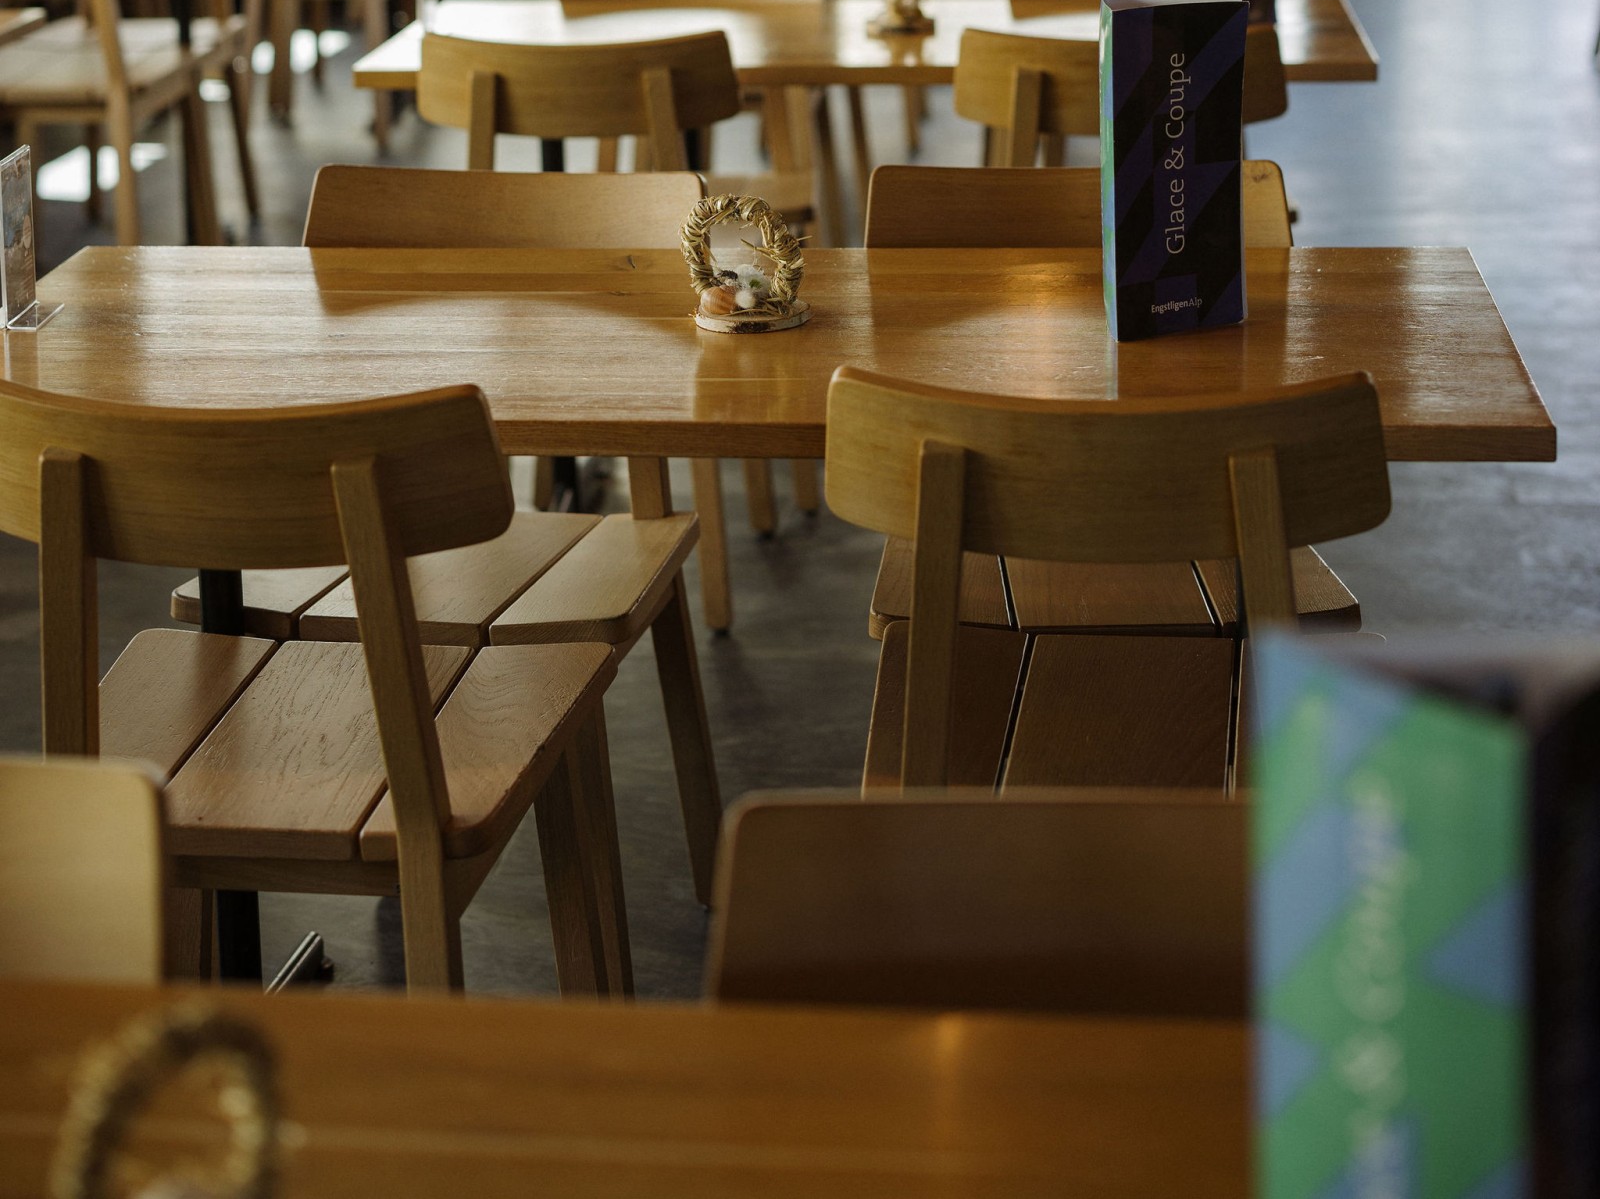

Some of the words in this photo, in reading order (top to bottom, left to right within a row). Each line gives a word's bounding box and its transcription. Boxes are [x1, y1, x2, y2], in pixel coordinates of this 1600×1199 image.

[1165, 53, 1191, 138] Coupe
[1164, 145, 1184, 170] &
[1166, 178, 1185, 254] Glace
